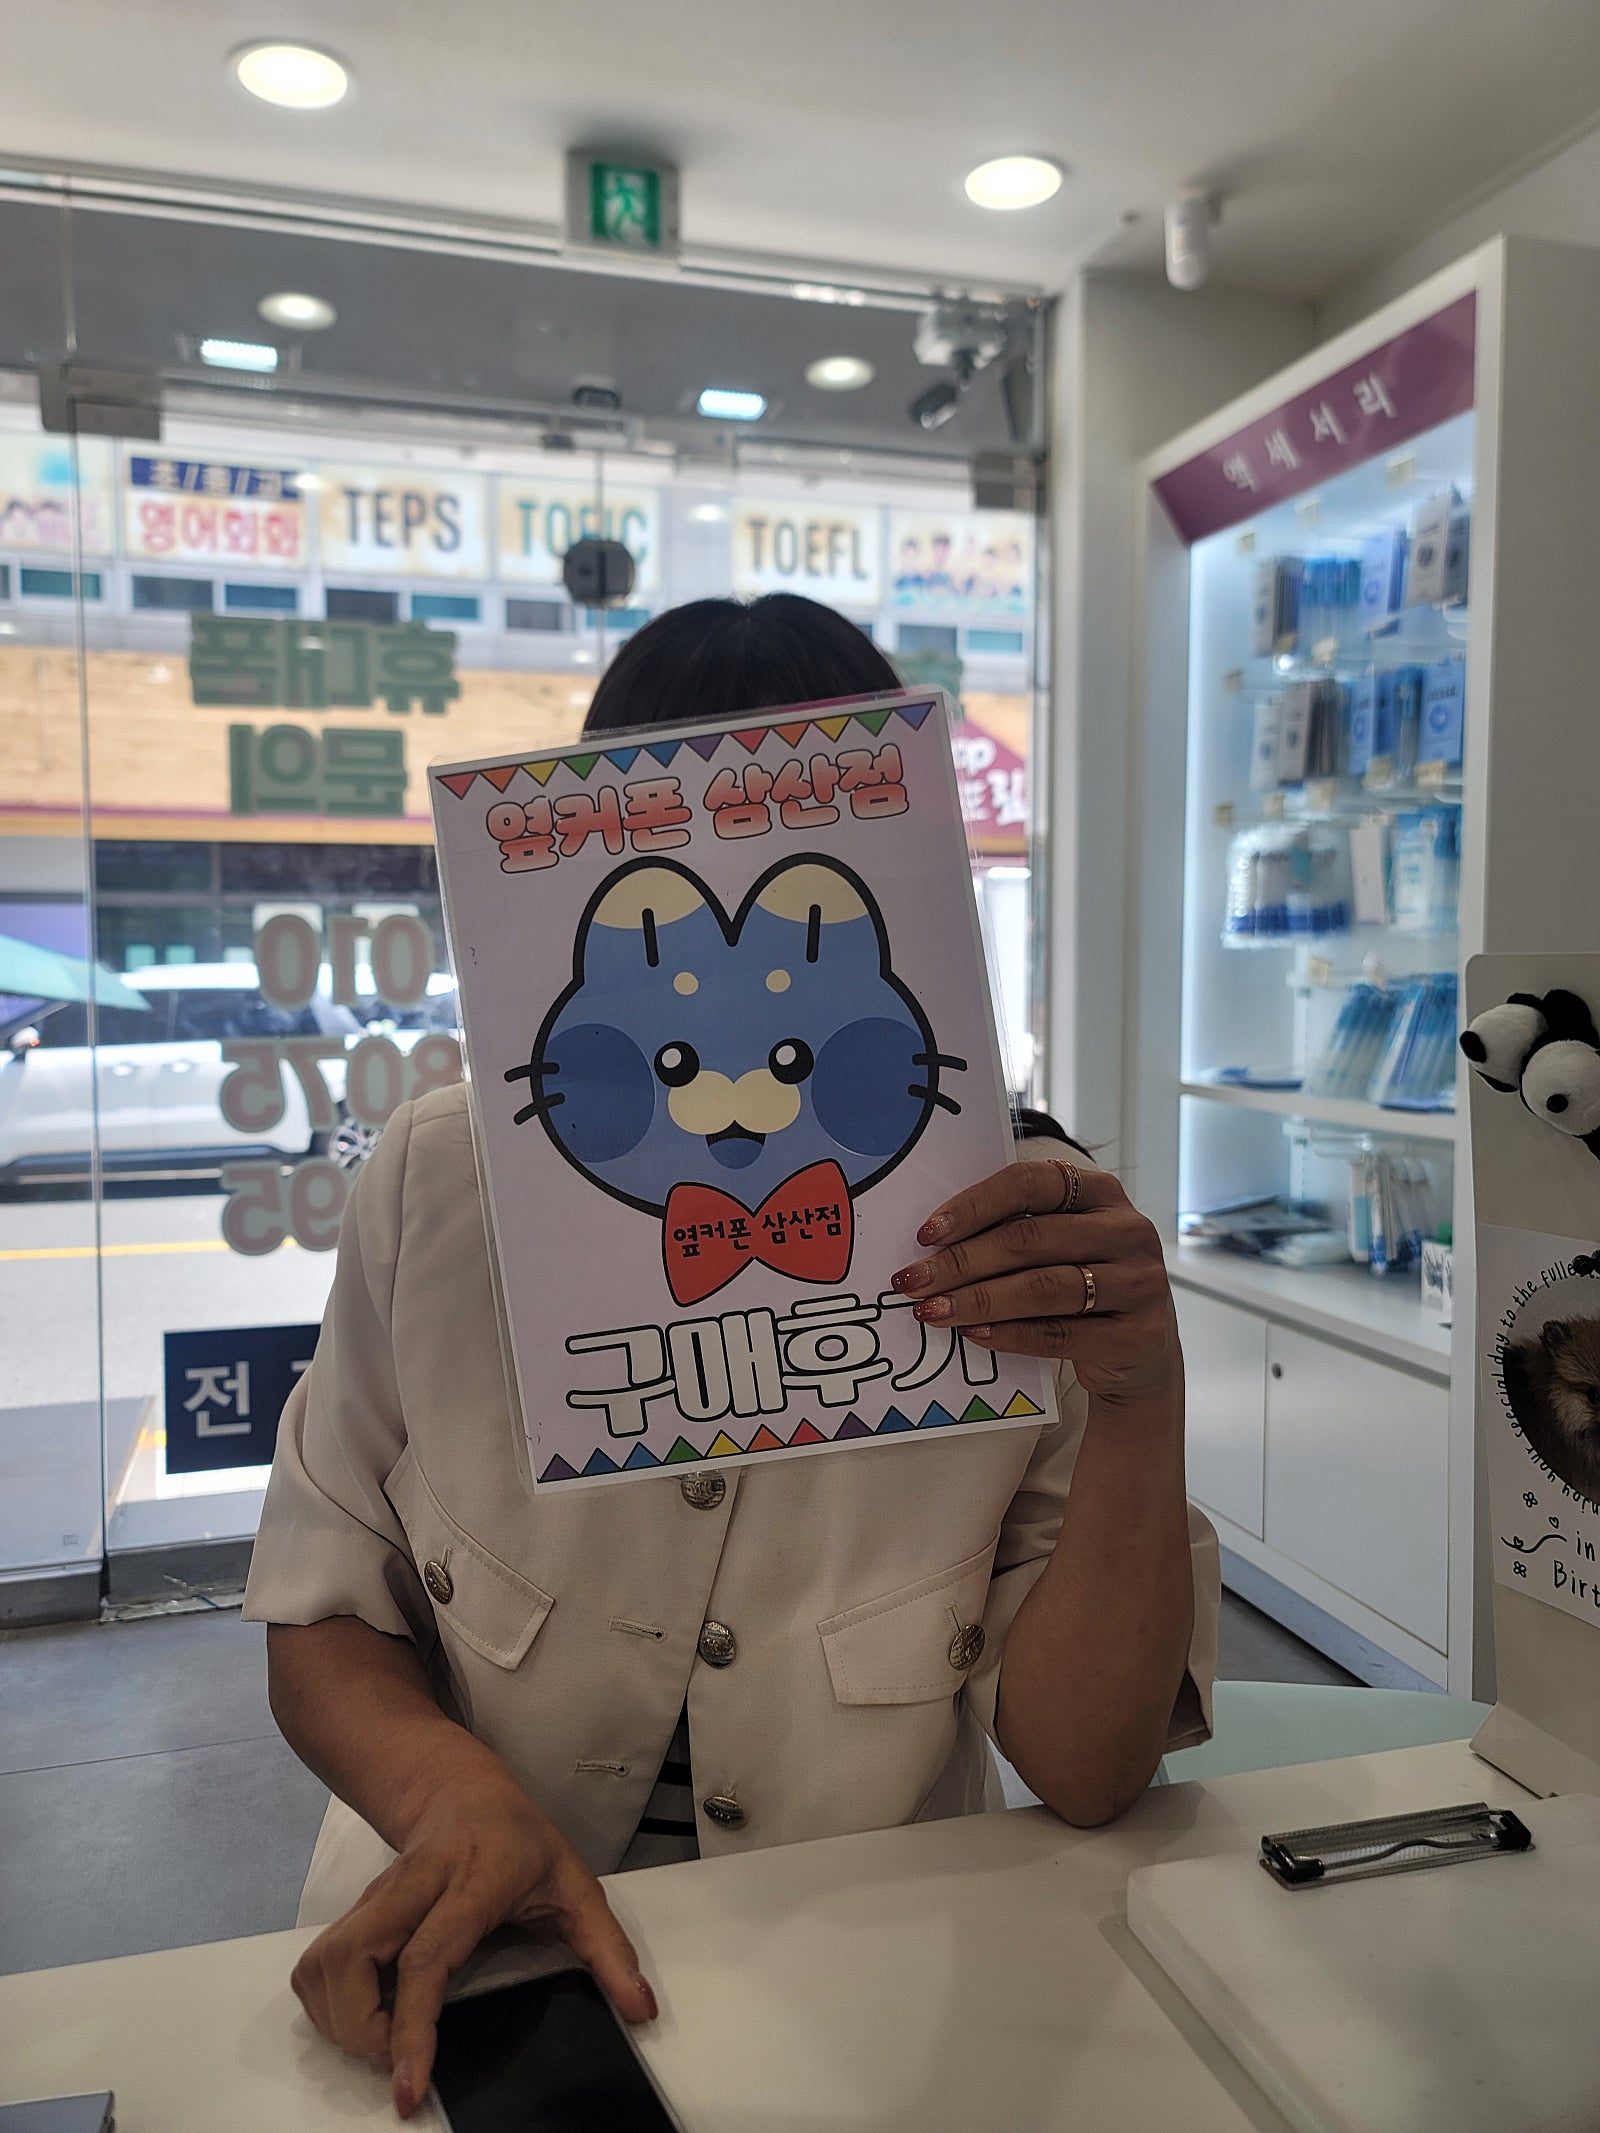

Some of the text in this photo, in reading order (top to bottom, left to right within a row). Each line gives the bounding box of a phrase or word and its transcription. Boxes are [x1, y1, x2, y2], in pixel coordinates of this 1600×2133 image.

[139, 501, 299, 556] 영어회화
[342, 486, 461, 553] TEPS
[745, 516, 869, 580] TOEFL
[486, 742, 910, 874] 옆커폰 삼산점
[673, 1203, 842, 1258] 옆커폰 삼산점
[1500, 1309, 1517, 1329] to
[1513, 1280, 1538, 1308] the
[1487, 1332, 1511, 1365] day
[1491, 1373, 1524, 1438] special
